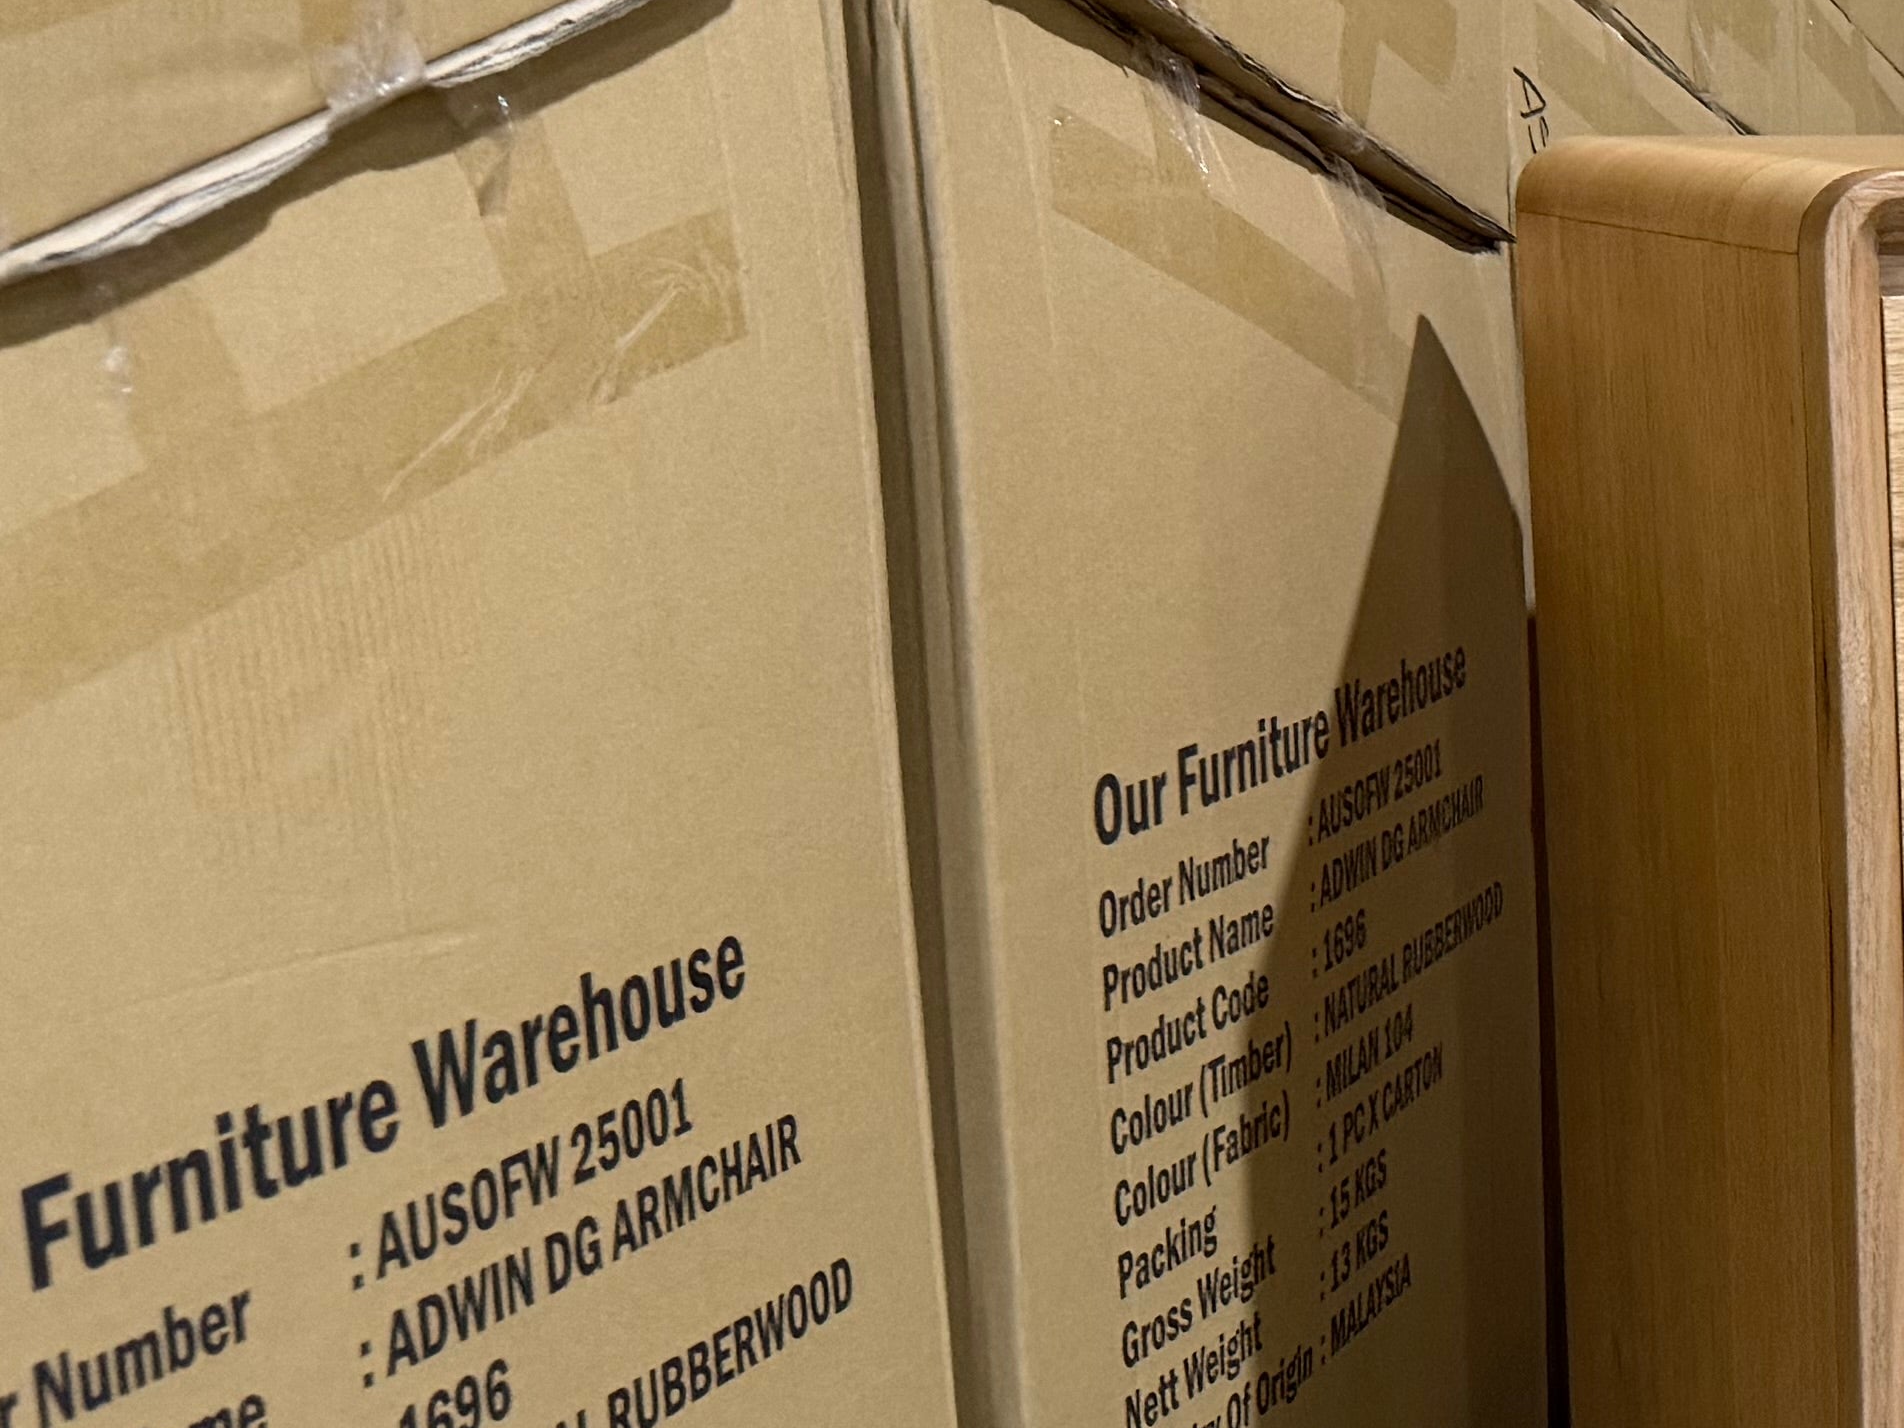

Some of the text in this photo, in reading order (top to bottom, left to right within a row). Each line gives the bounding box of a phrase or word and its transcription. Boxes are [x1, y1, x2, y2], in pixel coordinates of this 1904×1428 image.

[1092, 644, 1467, 846] Our Furniture Warehouse
[1105, 995, 1208, 1085] Product
[1210, 969, 1270, 1031] Code
[1322, 907, 1367, 973] 1696
[19, 934, 746, 1292] Furniture Warehouse
[375, 1133, 560, 1280] AUSOFW
[569, 1076, 693, 1186] 25001
